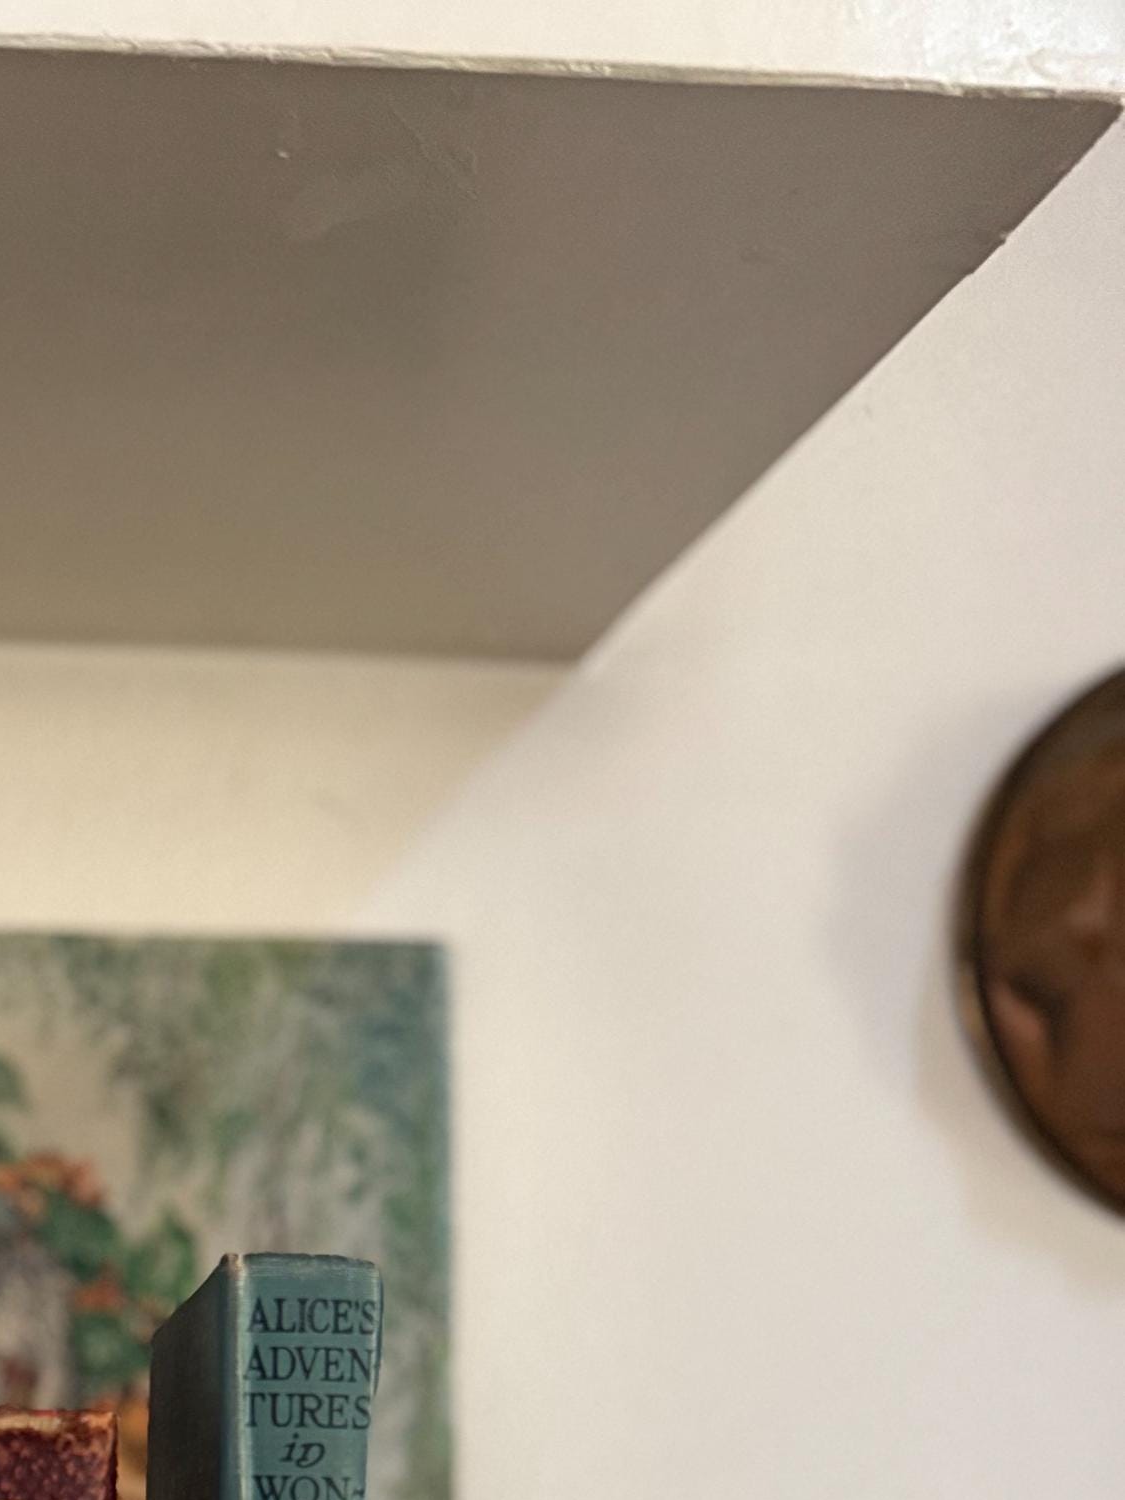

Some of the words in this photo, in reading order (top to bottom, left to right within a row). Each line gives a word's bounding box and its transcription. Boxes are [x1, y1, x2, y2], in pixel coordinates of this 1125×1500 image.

[248, 1297, 374, 1335] ALICE'S
[244, 1392, 371, 1429] TURES
[281, 1433, 325, 1468] in
